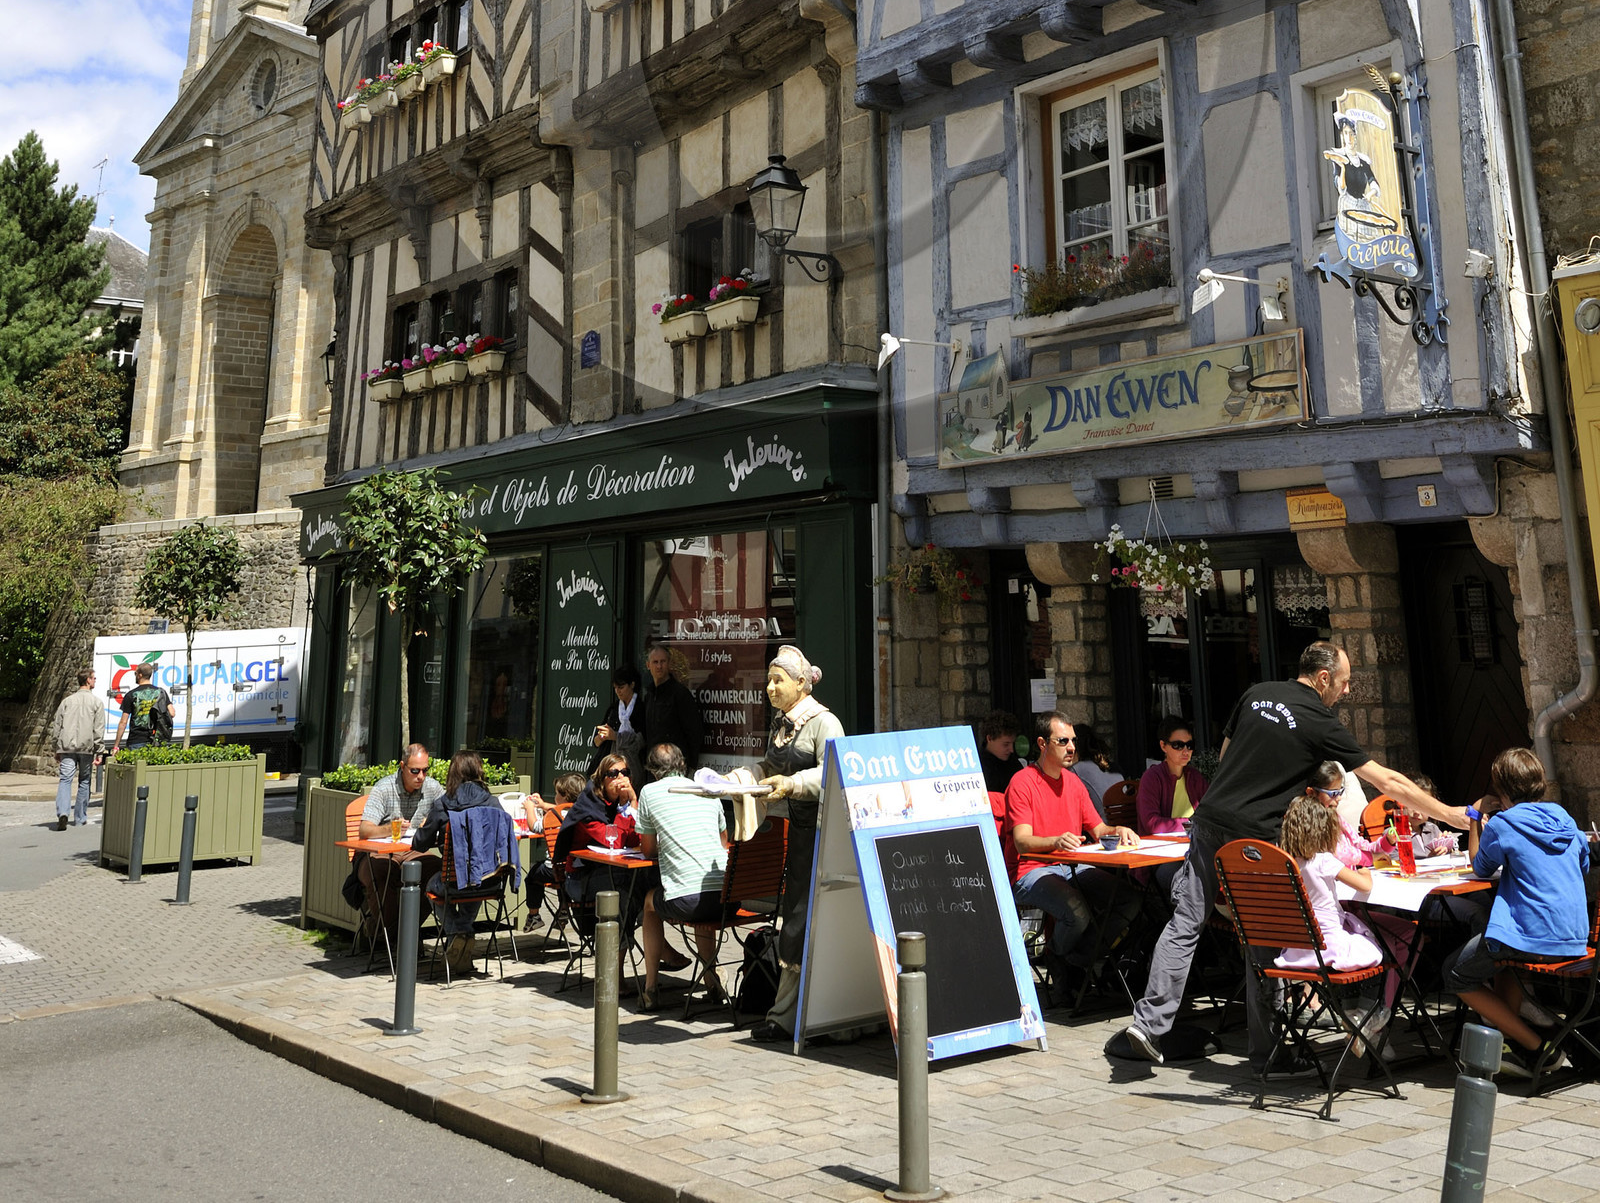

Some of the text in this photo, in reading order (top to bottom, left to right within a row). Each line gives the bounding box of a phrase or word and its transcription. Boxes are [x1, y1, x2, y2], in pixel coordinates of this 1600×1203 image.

[1347, 237, 1415, 266] Crêperie
[1043, 360, 1212, 433] DAN EWEN
[723, 434, 806, 492] Interior's
[480, 484, 499, 518] et
[501, 475, 550, 525] Objets
[556, 470, 578, 506] de
[586, 454, 696, 501] Décoration
[556, 569, 606, 609] Interior's
[561, 625, 599, 647] Meubles
[551, 648, 610, 671] en Pin Cirés
[700, 648, 732, 665] 16 styles
[153, 660, 289, 688] TOUPARGEL
[171, 688, 289, 706] sugelés à domicile
[559, 686, 598, 716] Canapés
[700, 689, 762, 705] COMMERCIALE
[703, 709, 746, 725] KERLANN
[1251, 700, 1297, 729] Dan Ewen
[558, 723, 596, 754] Objets d
[716, 729, 762, 751] d'exposition
[554, 748, 592, 773] Décorati
[843, 744, 977, 782] Dan Ewen
[933, 776, 981, 794] Crêperie
[945, 849, 965, 865] du
